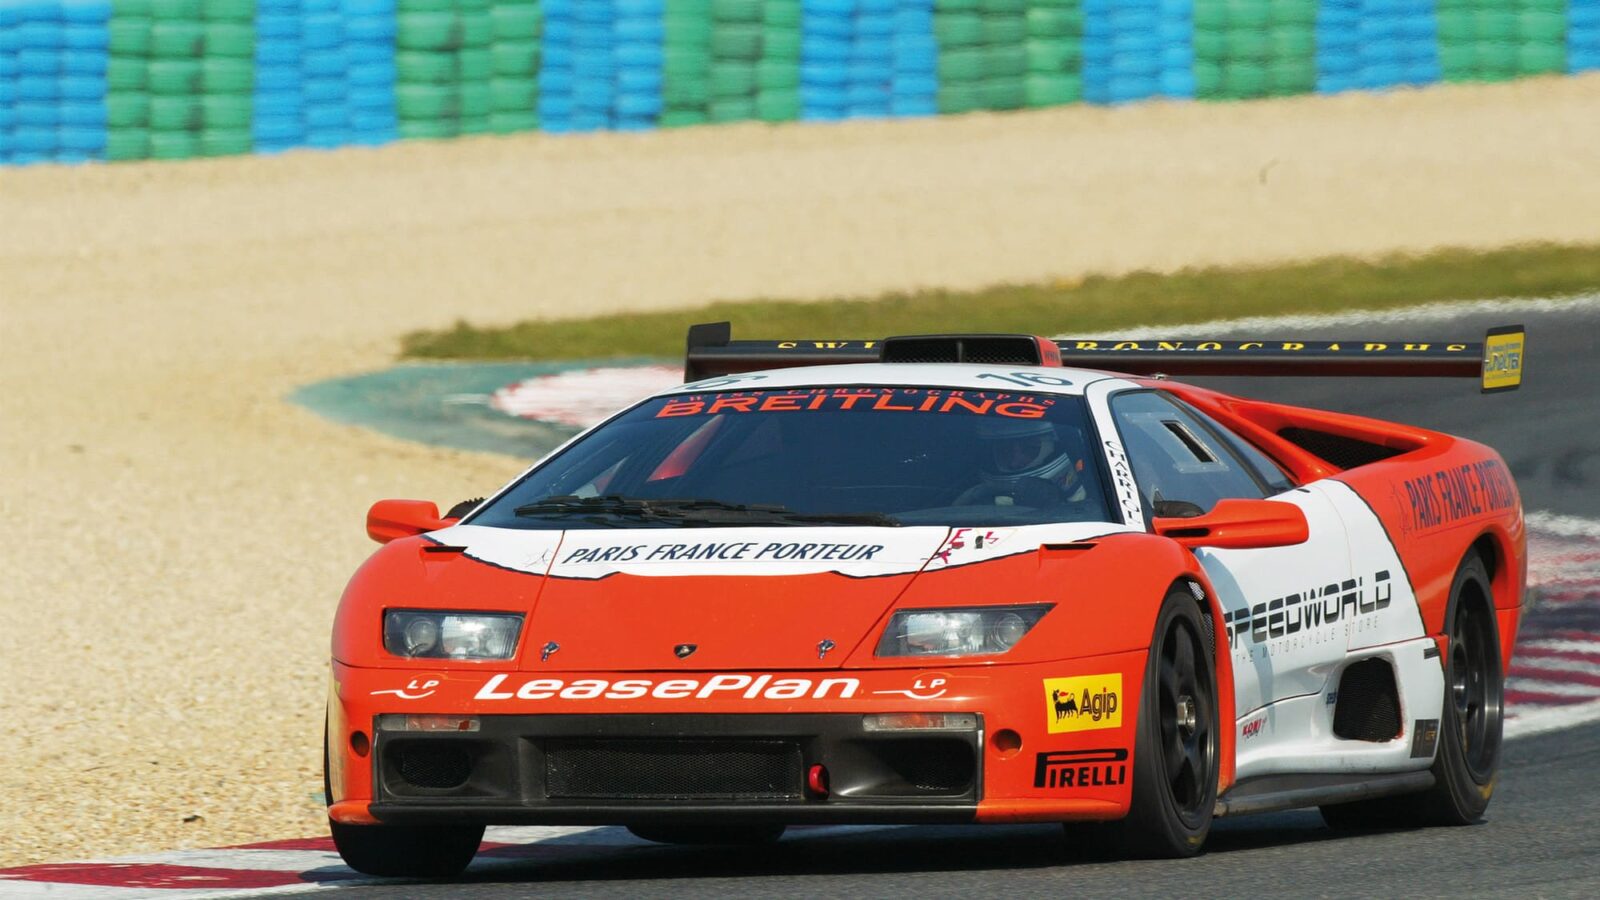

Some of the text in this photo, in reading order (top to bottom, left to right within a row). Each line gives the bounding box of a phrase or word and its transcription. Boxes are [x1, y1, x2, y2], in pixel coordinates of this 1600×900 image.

[976, 372, 1073, 387] 16
[655, 393, 1049, 419] BREITLING
[561, 543, 884, 564] PARIS FRANCE PORTEUR
[1261, 626, 1336, 659] MOTORCYCLE
[1344, 615, 1379, 638] STORE
[406, 679, 440, 690] LP
[473, 673, 860, 701] LeasePlan
[913, 678, 947, 689] LP
[1079, 687, 1118, 722] Agip
[1034, 748, 1129, 788] PIRELLI
